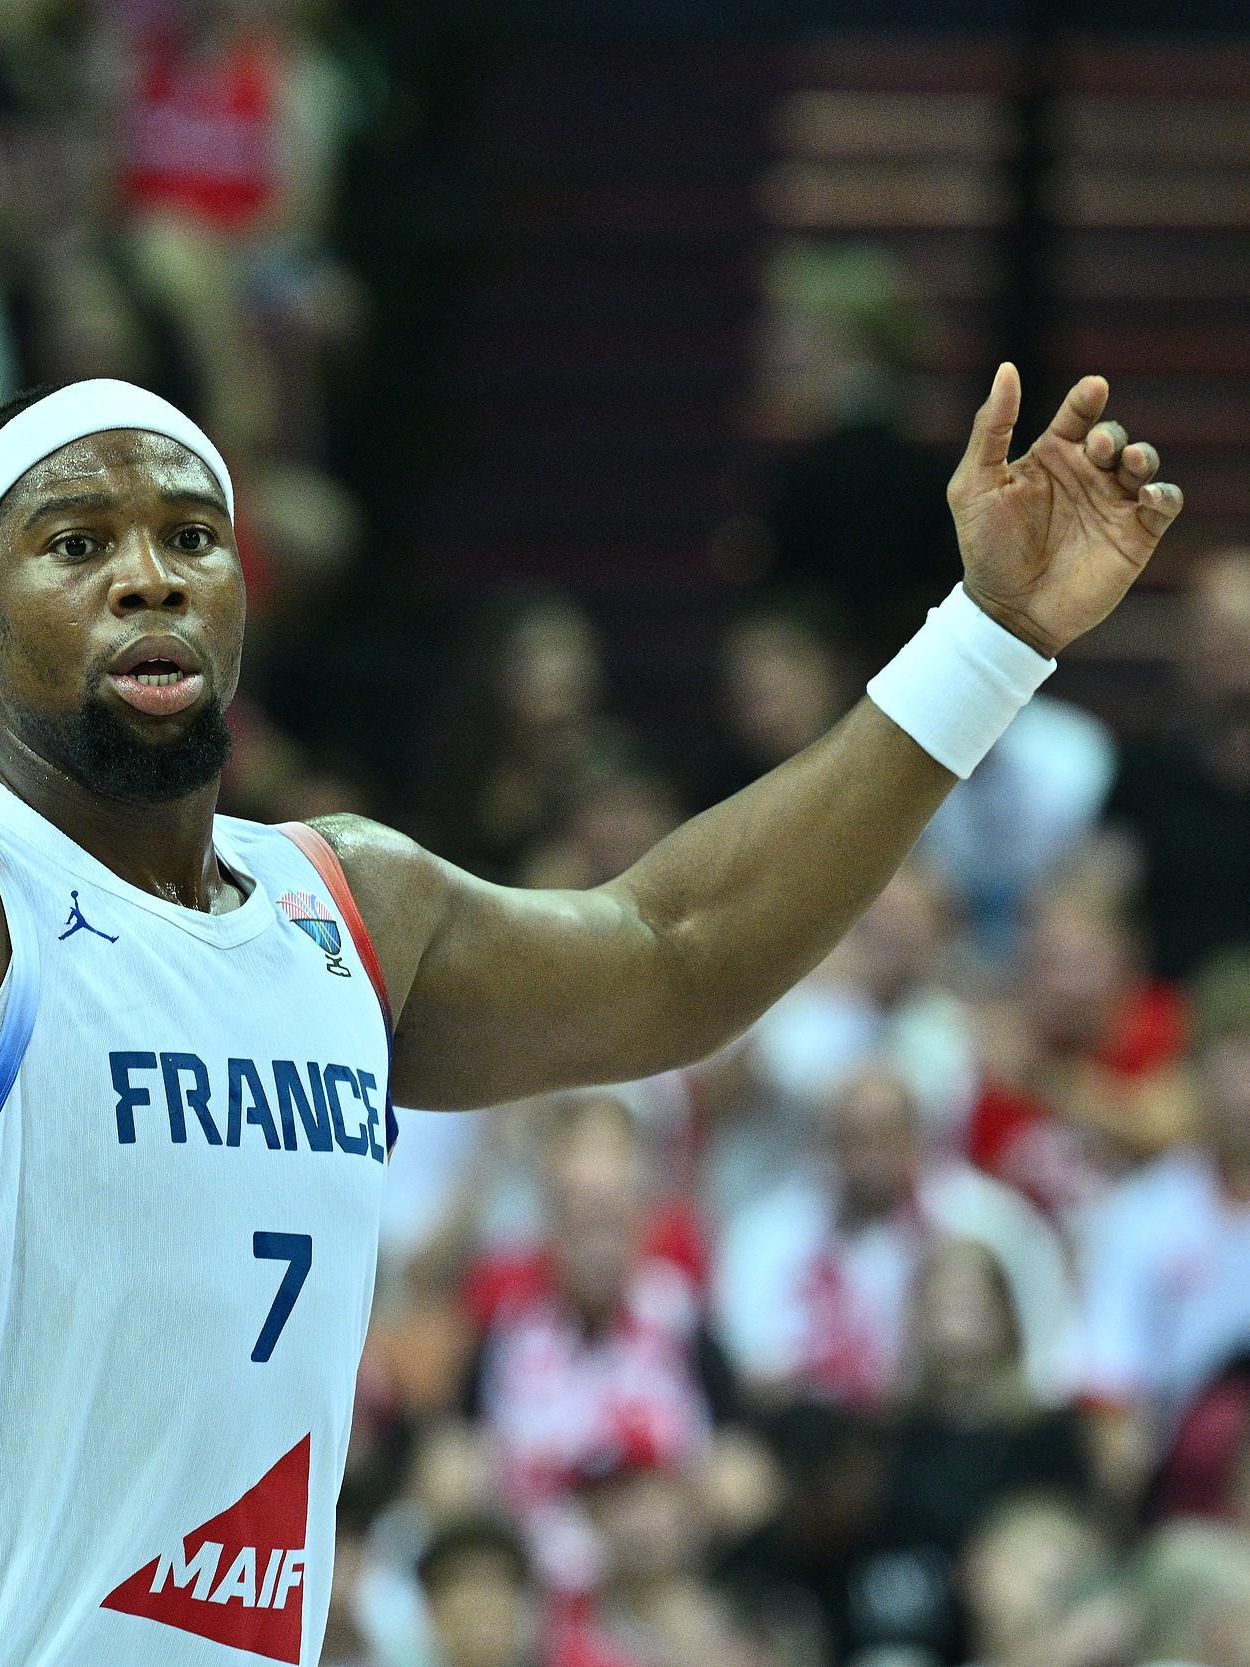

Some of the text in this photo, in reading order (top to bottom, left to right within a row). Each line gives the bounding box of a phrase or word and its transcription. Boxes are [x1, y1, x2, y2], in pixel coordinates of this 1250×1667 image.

[109, 1051, 384, 1164] FRANCE
[250, 1231, 312, 1363] 7
[148, 1540, 306, 1610] MAIF
